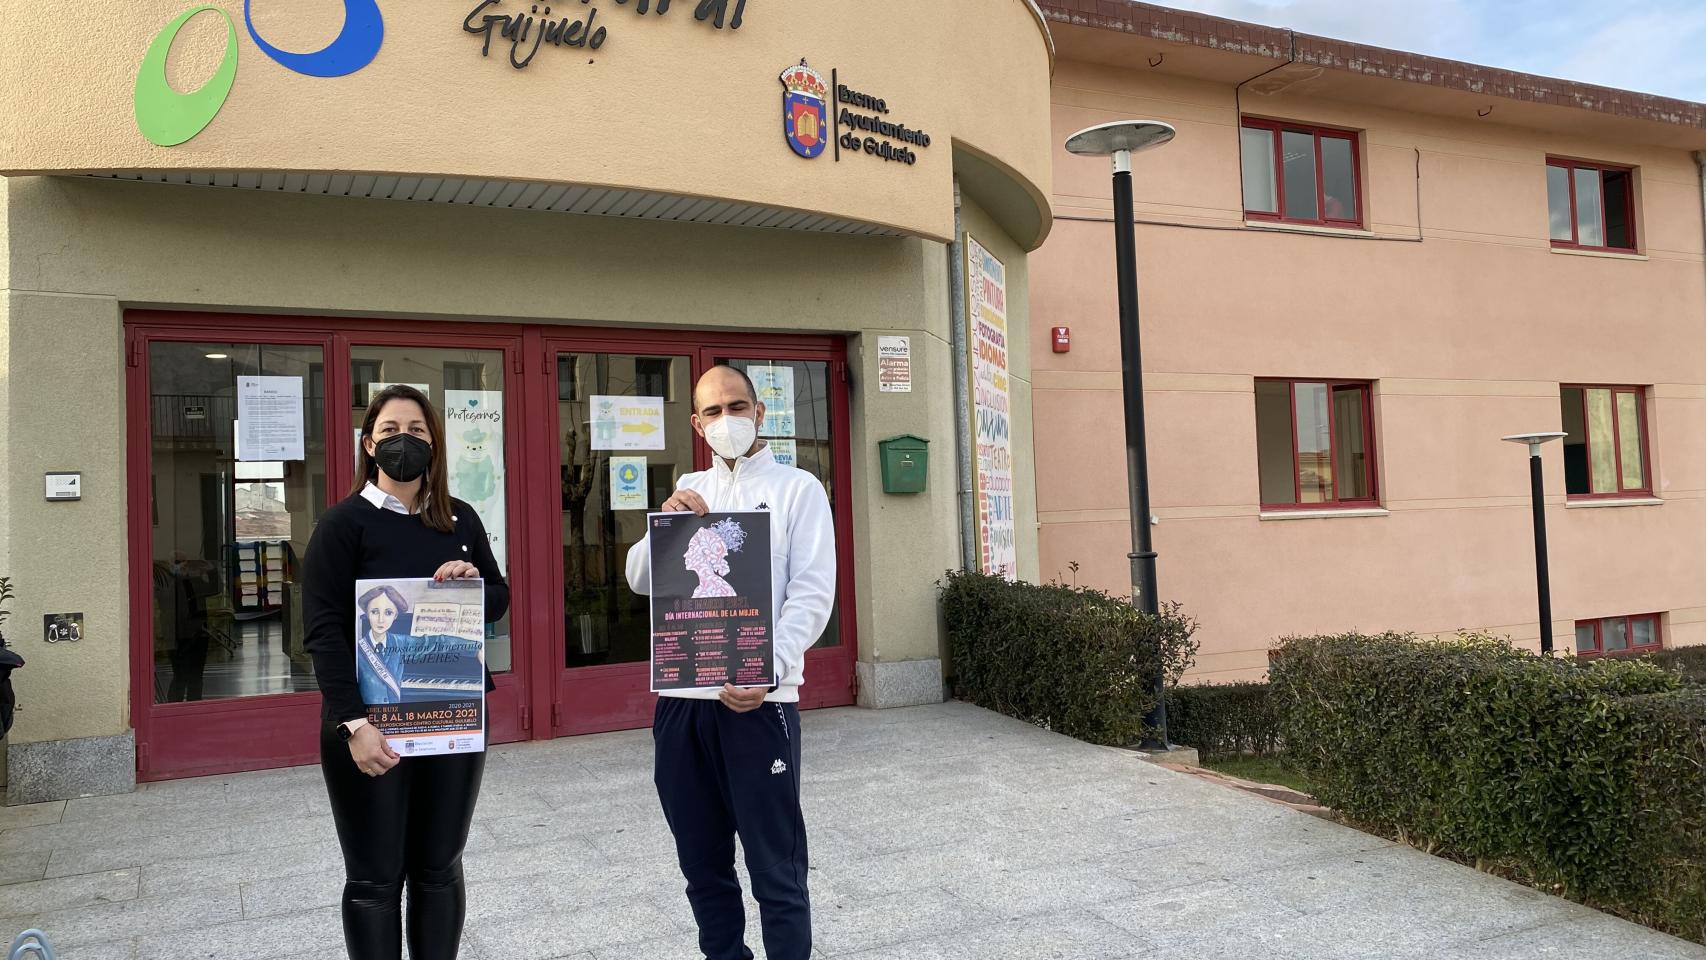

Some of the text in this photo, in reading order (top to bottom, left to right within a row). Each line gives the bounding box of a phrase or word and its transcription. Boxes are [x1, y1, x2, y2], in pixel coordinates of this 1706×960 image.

[463, 0, 607, 69] Guijuelo
[839, 109, 932, 148] Ayuntamiento
[840, 132, 916, 166] de Guijuelo
[978, 337, 1006, 371] IDIOMAS
[880, 358, 909, 368] Alarma
[447, 407, 501, 423] Protegernos
[619, 407, 660, 416] ENTRADA
[665, 608, 759, 621] DÍA INTERNACIONAL DE LA MUJER
[400, 652, 461, 665] MUJERES
[368, 708, 477, 723] EL 8 AL 18 MARZO 2021
